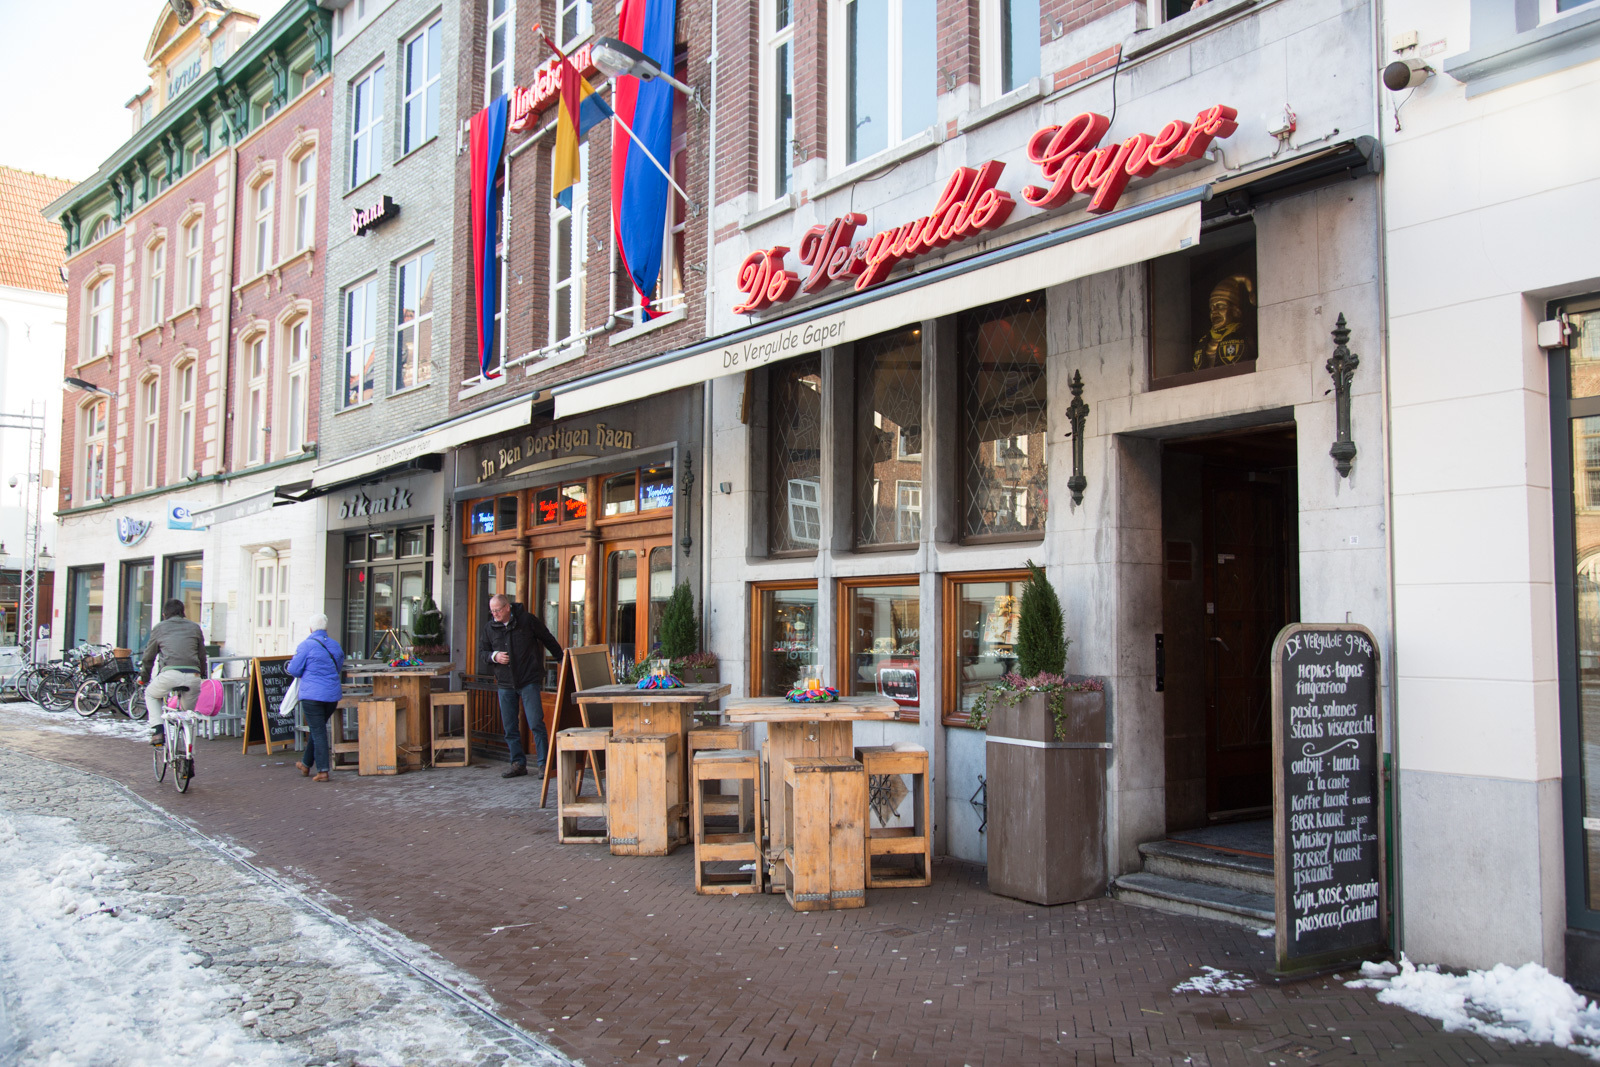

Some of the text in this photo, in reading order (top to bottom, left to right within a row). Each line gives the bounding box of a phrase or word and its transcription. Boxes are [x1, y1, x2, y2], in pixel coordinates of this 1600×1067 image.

[168, 57, 202, 101] LOTUS
[509, 42, 595, 133] Lindebom
[351, 194, 386, 237] Brand
[732, 104, 1239, 316] De Vergulde Gaper
[723, 320, 846, 368] De Vergulde Gaper
[481, 459, 496, 481] In
[499, 446, 521, 470] Den
[526, 428, 588, 457] Dorstigen
[338, 487, 412, 519] bikmik
[1332, 754, 1360, 771] lunch
